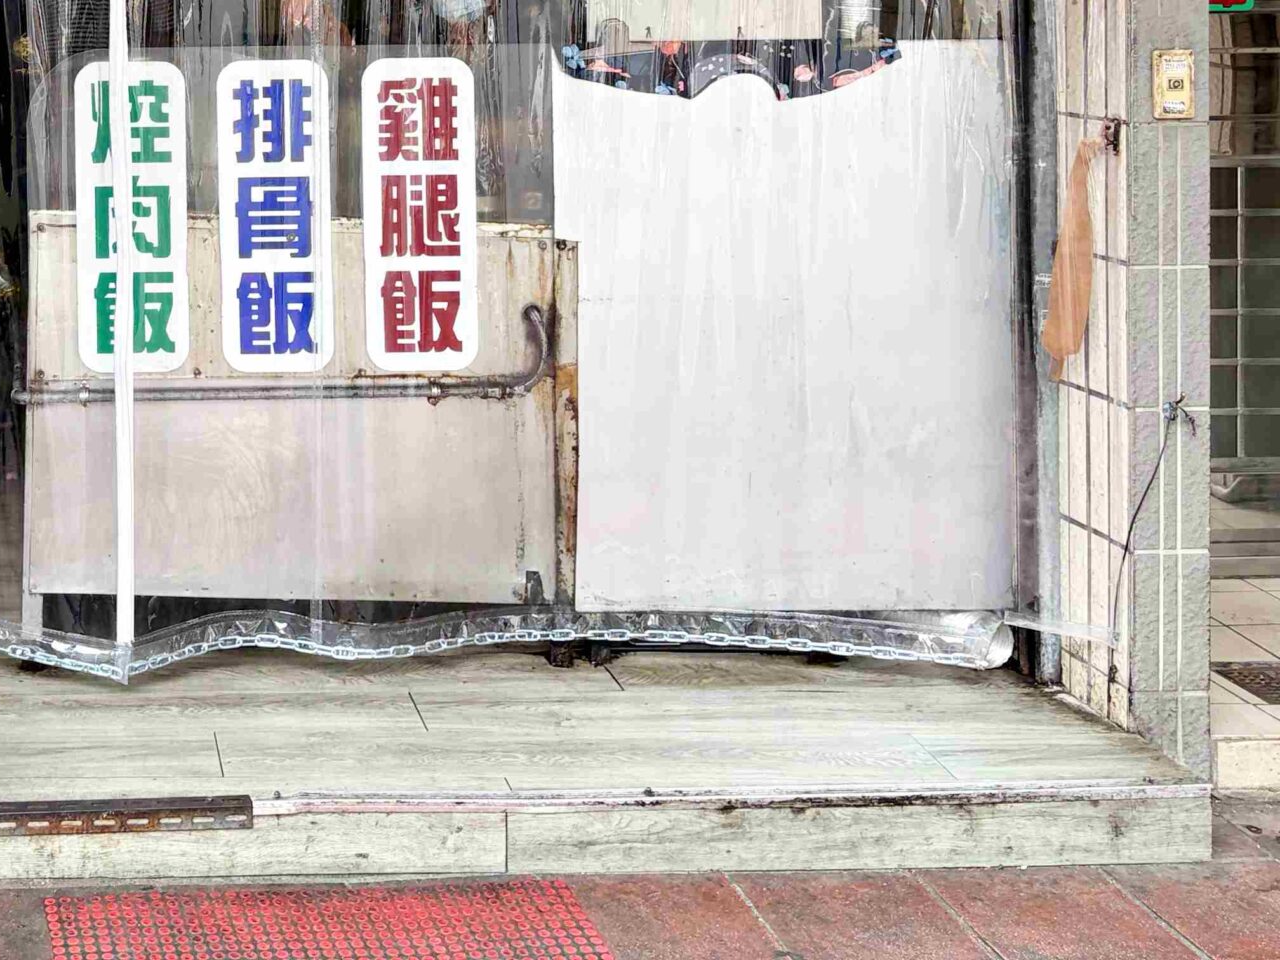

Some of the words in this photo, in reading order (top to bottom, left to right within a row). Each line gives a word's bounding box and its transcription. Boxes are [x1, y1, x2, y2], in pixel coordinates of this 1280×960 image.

[232, 79, 318, 355] 排骨飯
[377, 77, 463, 353] 雞腿飯
